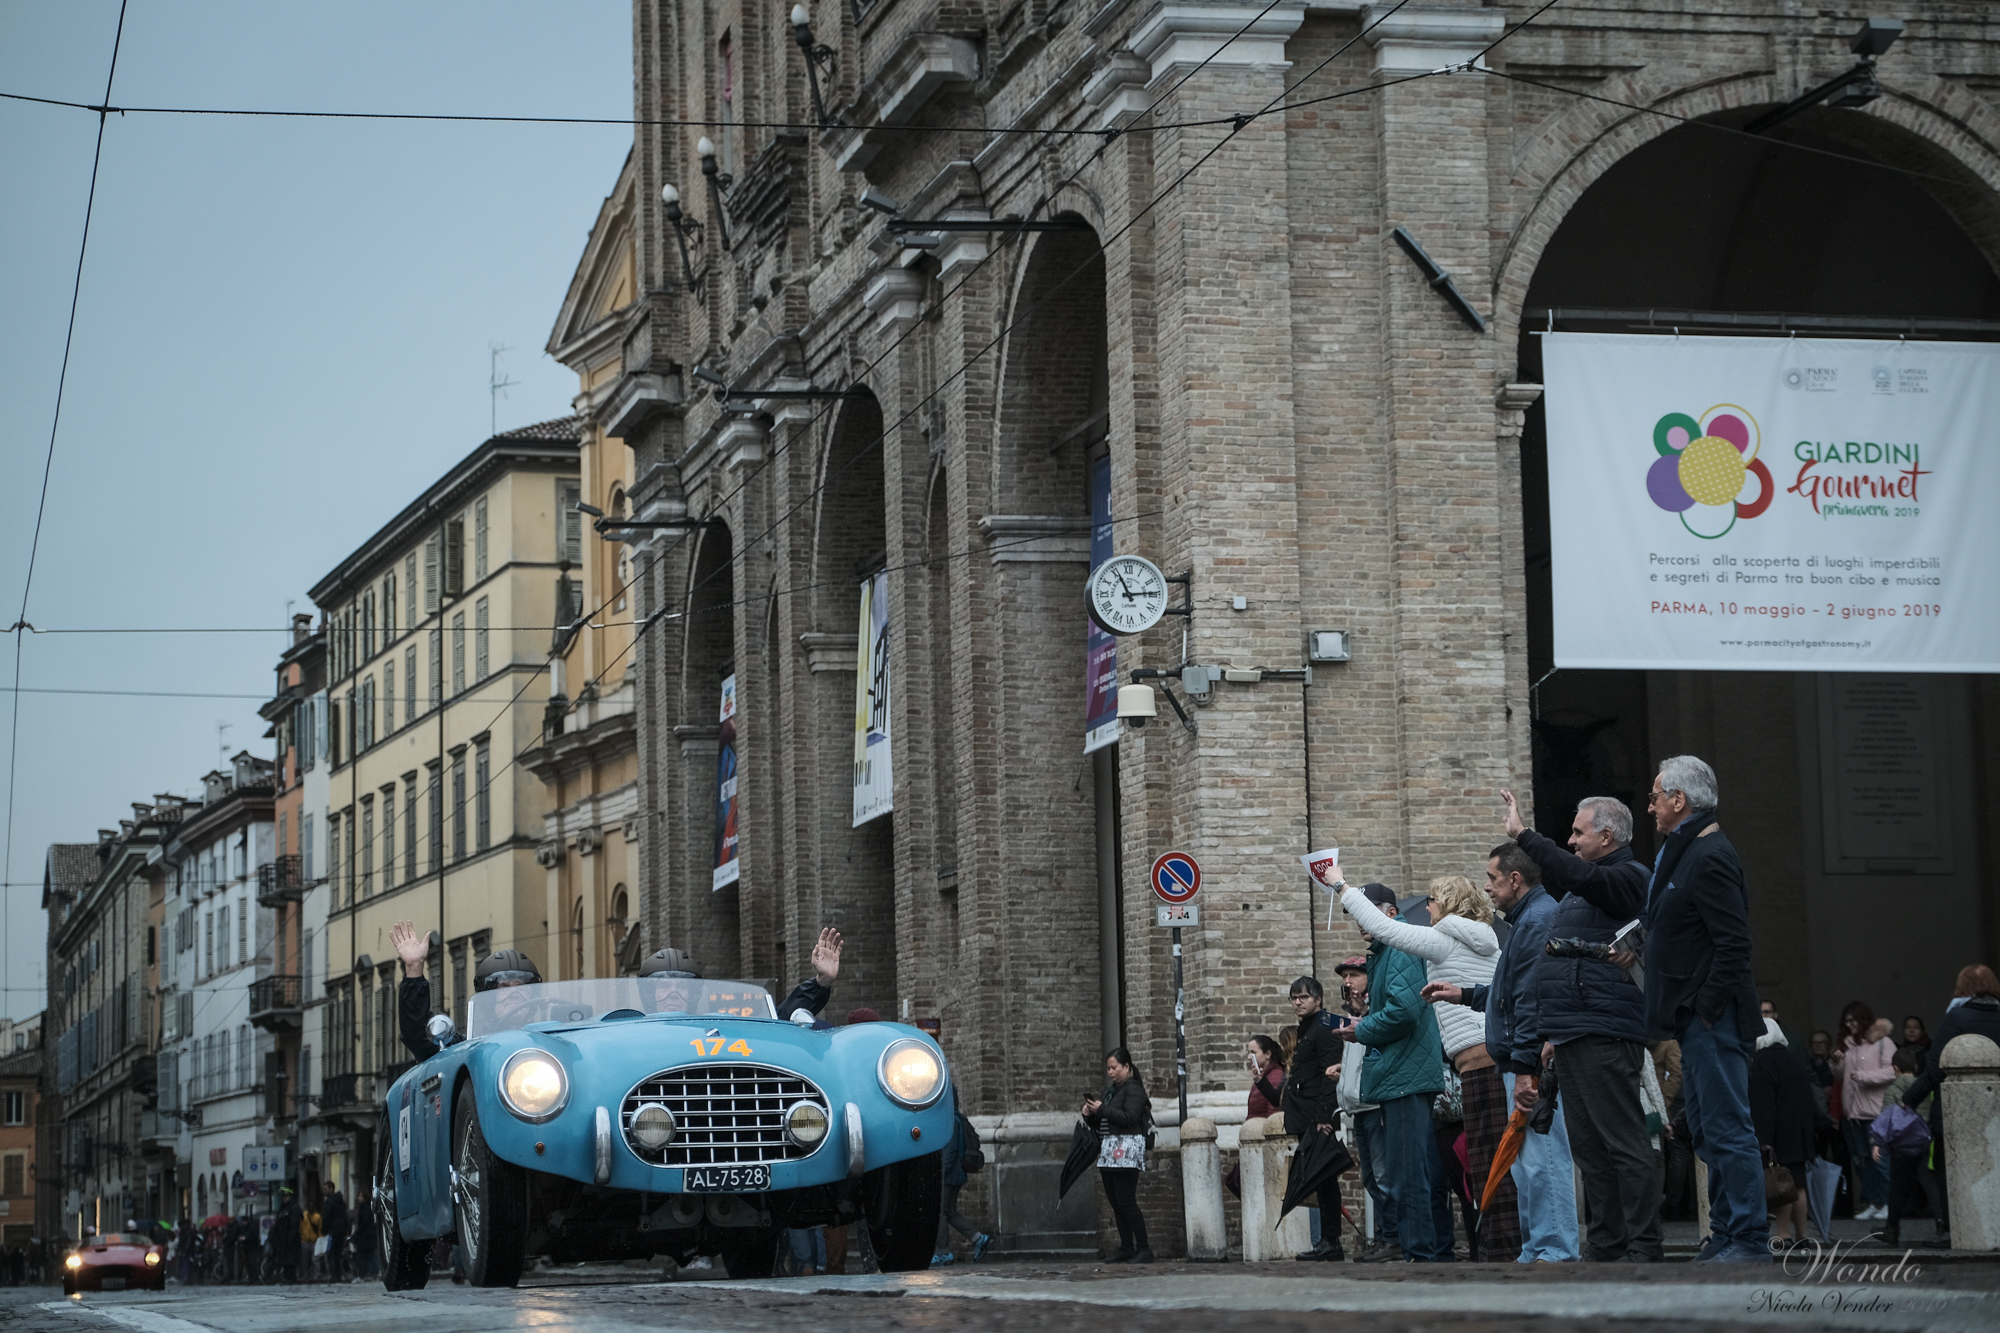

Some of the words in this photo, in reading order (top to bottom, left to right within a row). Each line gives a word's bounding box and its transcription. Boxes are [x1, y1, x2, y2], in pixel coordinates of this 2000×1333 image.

[1795, 441, 1919, 464] GIARDINI
[1787, 459, 1934, 515] Gourmet
[1823, 502, 1889, 520] primavera
[1894, 508, 1920, 517] 2019
[1649, 553, 1700, 566] Percorsi
[1712, 554, 1738, 566] alla
[1743, 556, 1800, 569] scoperta
[1806, 556, 1819, 567] di
[1825, 556, 1864, 571] luoghi
[1869, 557, 1940, 571] imperdibili
[1650, 573, 1658, 582] e
[1664, 571, 1710, 586] segreti
[1716, 572, 1729, 583] di
[1735, 571, 1778, 584] Parma
[1785, 573, 1804, 584] tra
[1810, 573, 1843, 584] buon
[1849, 574, 1876, 585] cibo
[1881, 576, 1890, 586] e
[1896, 575, 1941, 586] musica
[1651, 601, 1713, 616] PARMA,
[1720, 602, 1738, 615] 10
[1744, 603, 1806, 618] maggio
[1827, 603, 1835, 616] 2
[1841, 604, 1897, 620] giugno
[1902, 604, 1942, 617] 2019
[690, 1039, 753, 1056] 174
[692, 1168, 764, 1188] AL-75-28
